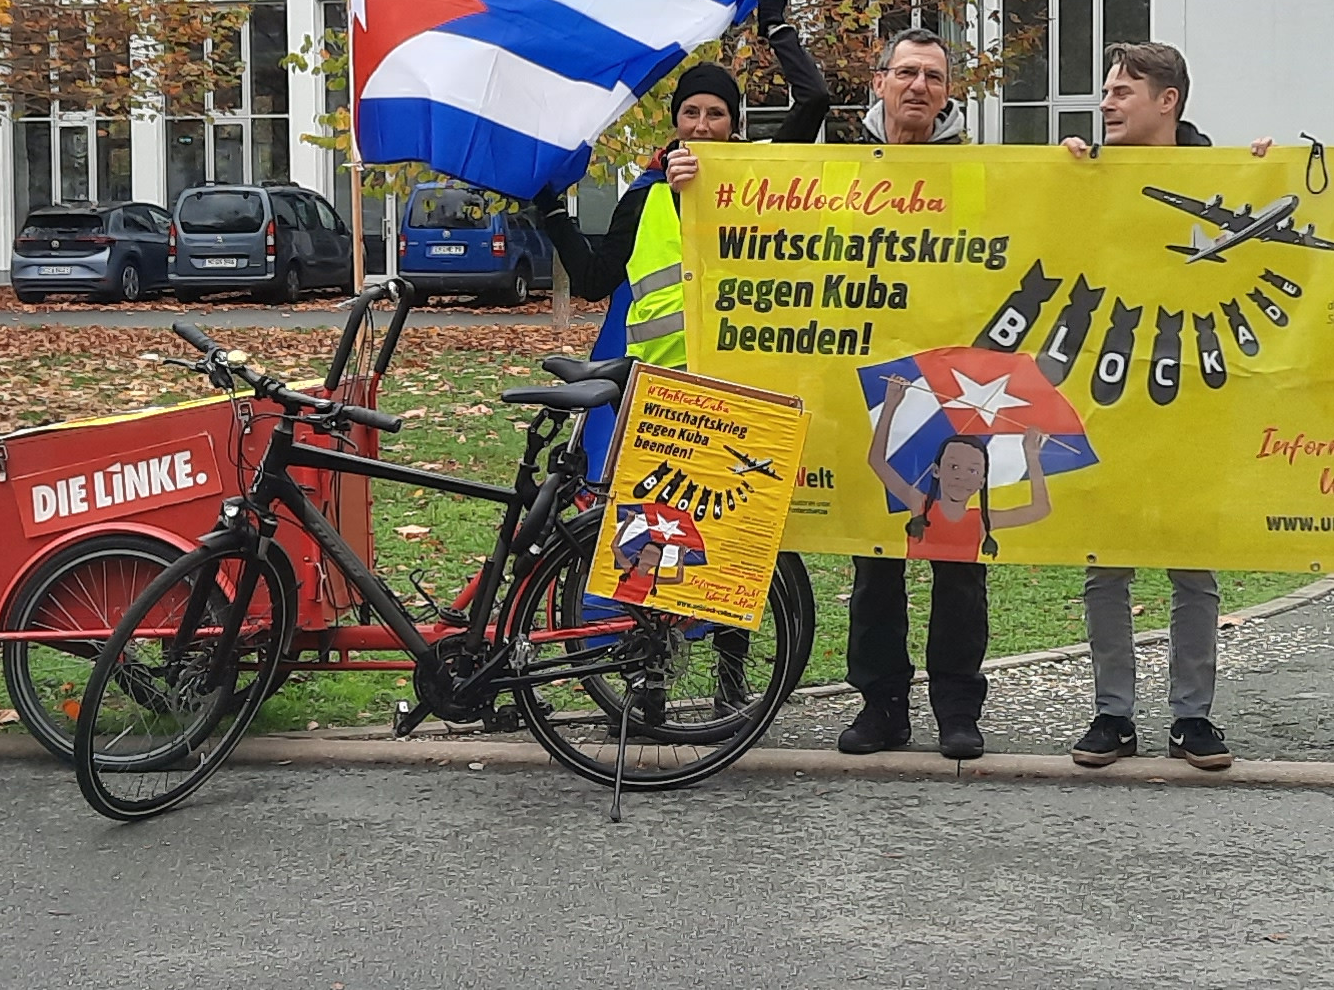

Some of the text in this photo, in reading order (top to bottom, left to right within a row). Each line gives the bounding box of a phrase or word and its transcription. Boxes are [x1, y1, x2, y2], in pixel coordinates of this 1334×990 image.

[715, 177, 946, 216] #UnblockCuba
[718, 225, 1009, 270] Wirtschaftskrieg
[715, 274, 909, 313] gegen Kuba
[717, 317, 873, 355] beenden!
[637, 421, 710, 446] gegen Kuba
[643, 402, 748, 439] Wirtschaftskrieg
[634, 435, 694, 459] beenden!
[32, 474, 89, 523] DIE
